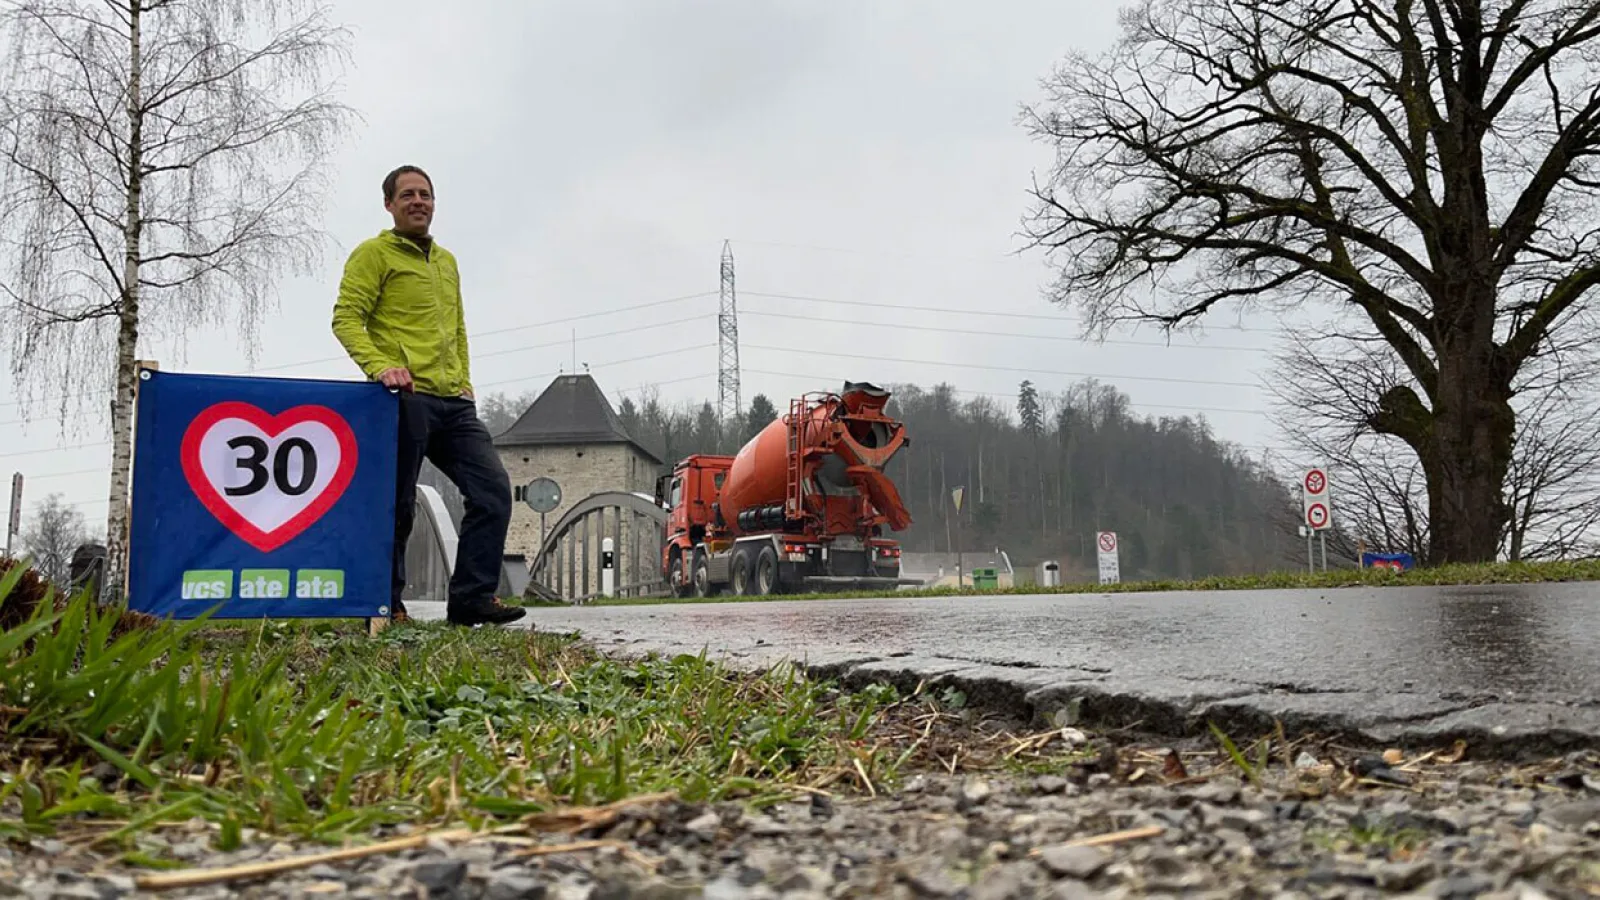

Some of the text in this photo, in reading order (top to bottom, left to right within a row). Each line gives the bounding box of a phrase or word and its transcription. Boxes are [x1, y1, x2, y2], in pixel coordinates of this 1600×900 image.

[224, 435, 317, 496] 30
[182, 575, 338, 599] vcs ate ata
